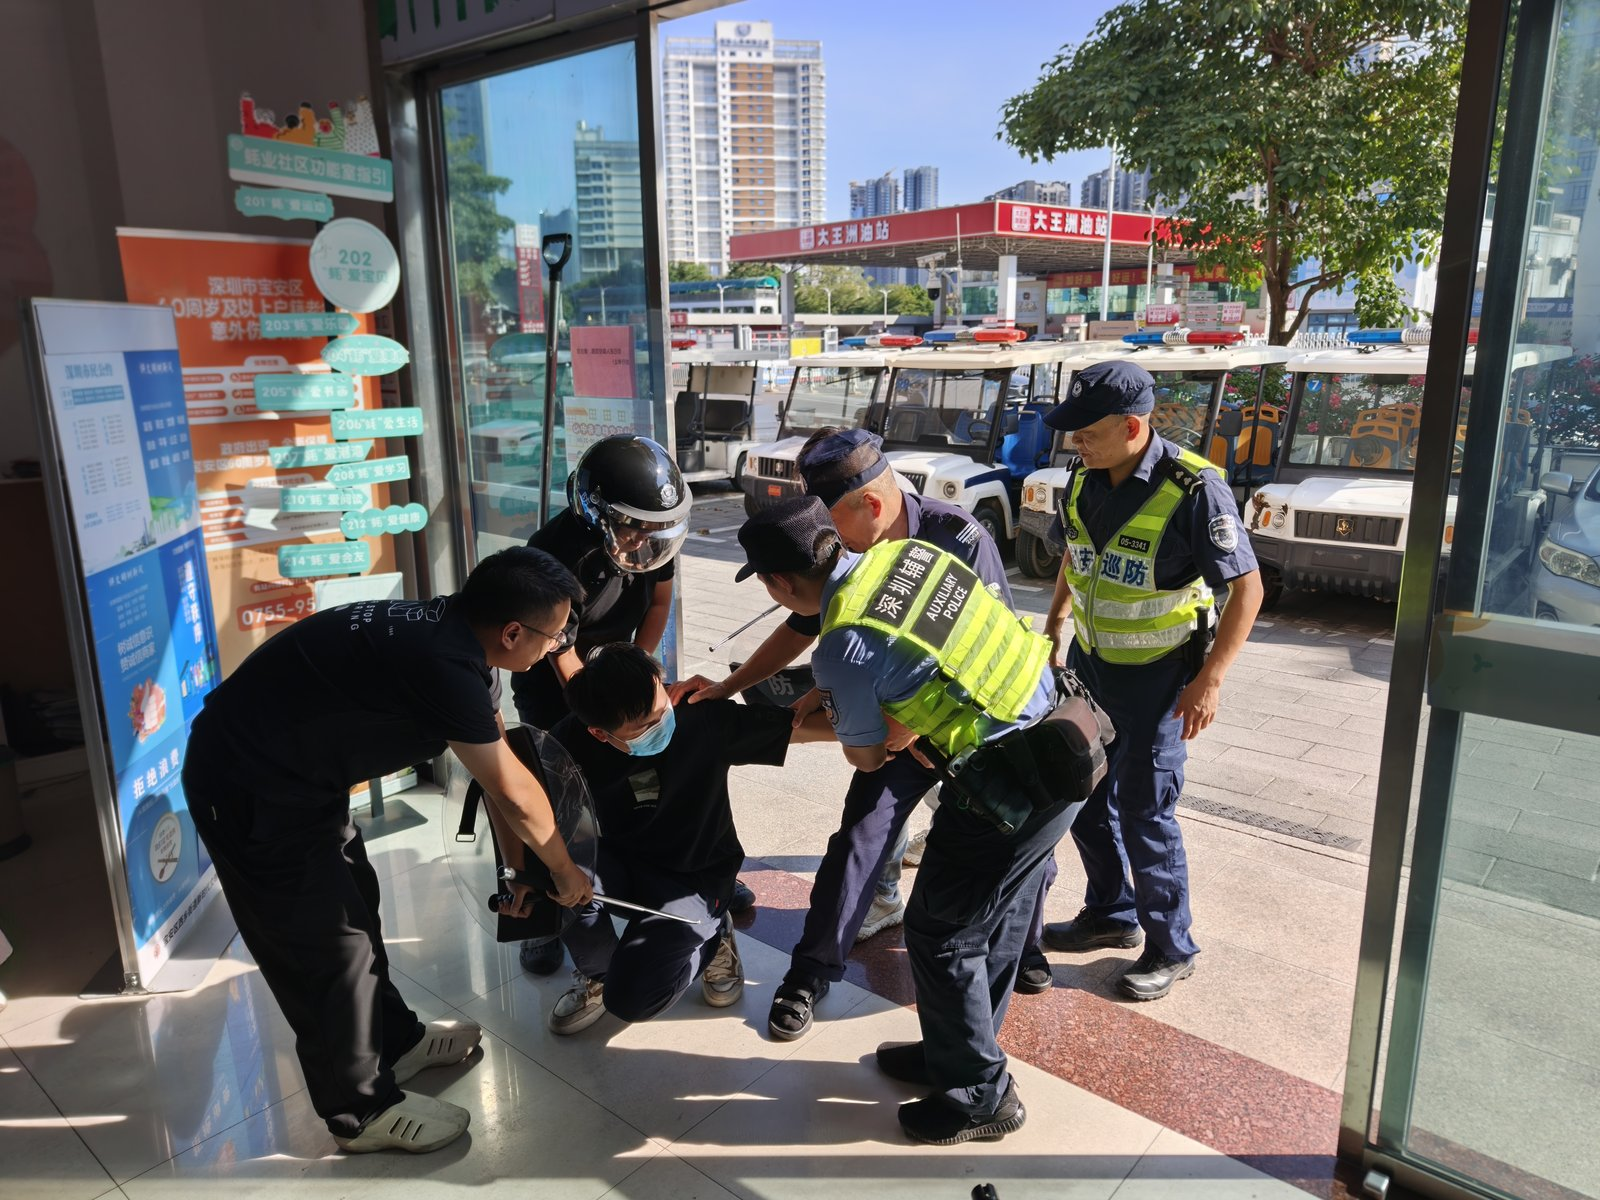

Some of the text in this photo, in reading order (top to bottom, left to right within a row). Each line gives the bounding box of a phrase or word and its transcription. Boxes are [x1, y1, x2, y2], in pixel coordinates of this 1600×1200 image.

[244, 149, 386, 186] 蚝业社区功能室指引
[818, 220, 889, 246] 大王洲油站
[1033, 210, 1107, 236] 大王洲油站
[338, 249, 372, 267] 202
[208, 276, 304, 297] 深圳市宝安区
[1312, 379, 1320, 391] 7
[1120, 537, 1147, 551] 05-3341
[875, 546, 934, 619] 深圳辅警
[926, 572, 958, 622] AUXILIARY
[943, 586, 968, 620] POLICE
[362, 604, 376, 623] STOP
[768, 674, 795, 696] 防
[132, 747, 181, 801] 拒绝浪费
